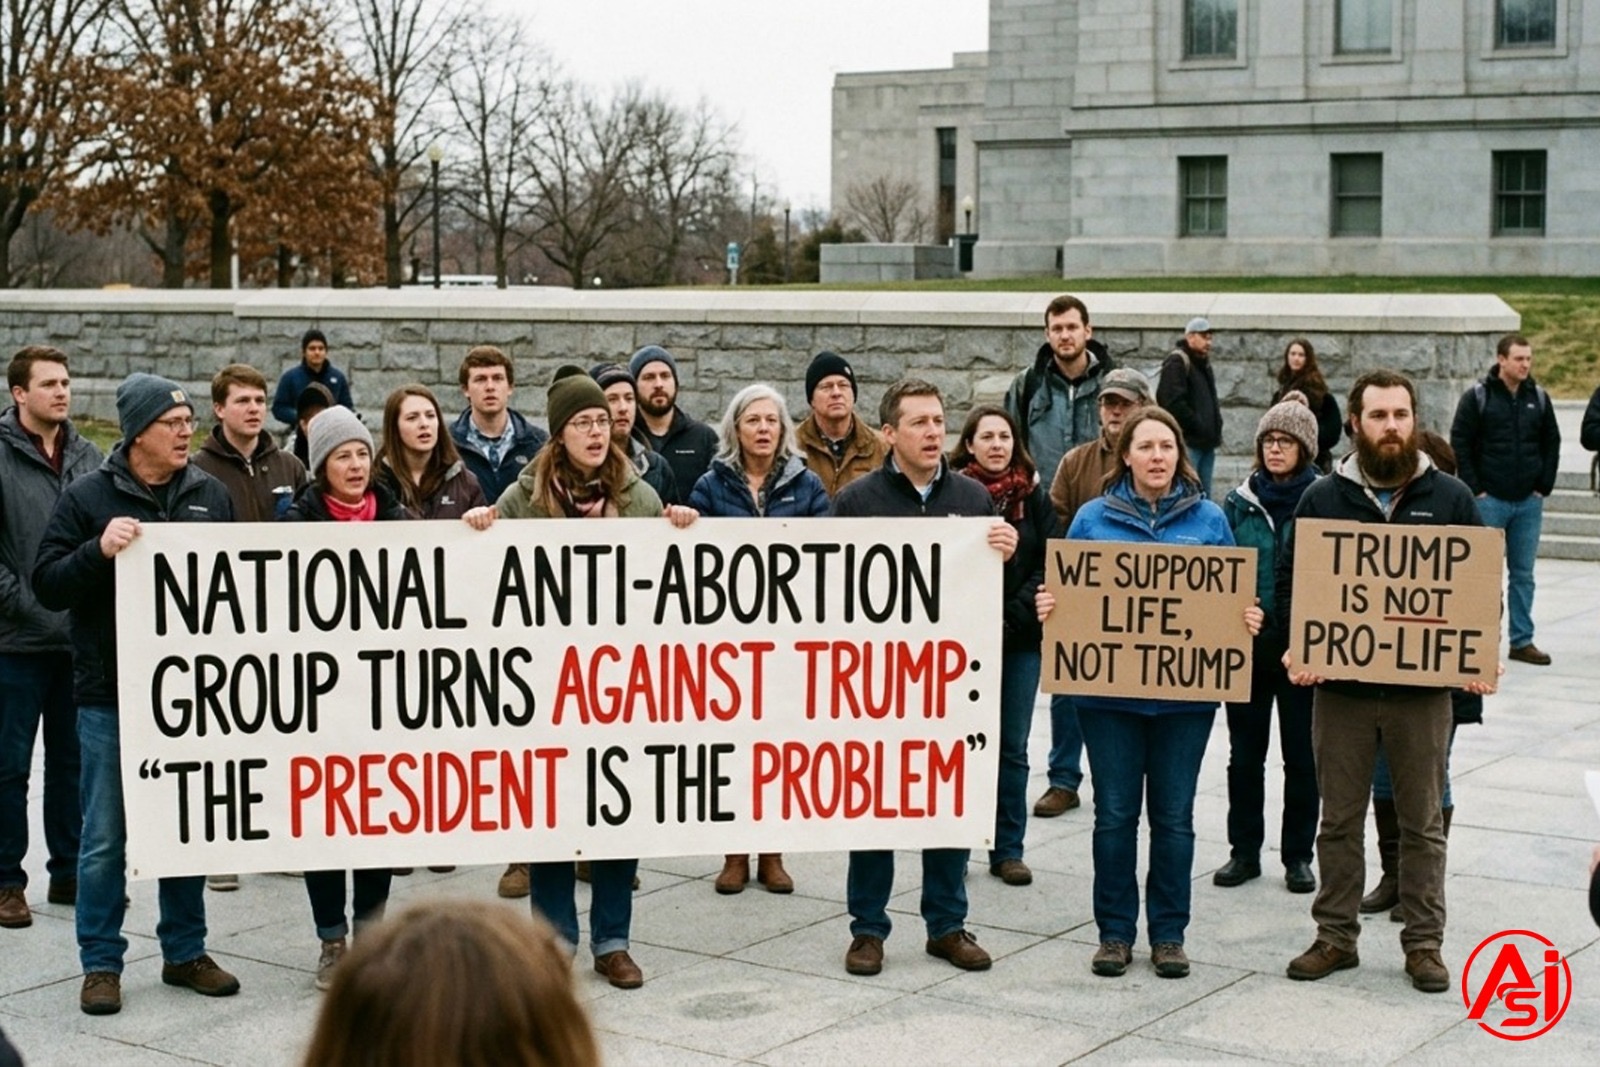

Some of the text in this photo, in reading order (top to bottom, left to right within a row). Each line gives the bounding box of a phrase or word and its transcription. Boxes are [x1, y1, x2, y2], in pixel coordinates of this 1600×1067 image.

[1054, 550, 1247, 595] WE SUPPORT
[1321, 530, 1472, 582] TRUMP
[153, 542, 941, 637] NATIONAL ANTI-ABORTION
[1340, 583, 1454, 618] IS NOT
[1101, 594, 1194, 642] LIFE,
[1054, 640, 1246, 691] NOT TRUMP
[1302, 619, 1483, 676] PRO-LIFE
[151, 639, 981, 739] GROUP TURNS AGAINST TRUMP:
[138, 732, 987, 845] “THE PRESIDENT IS THE PROBLEM”
